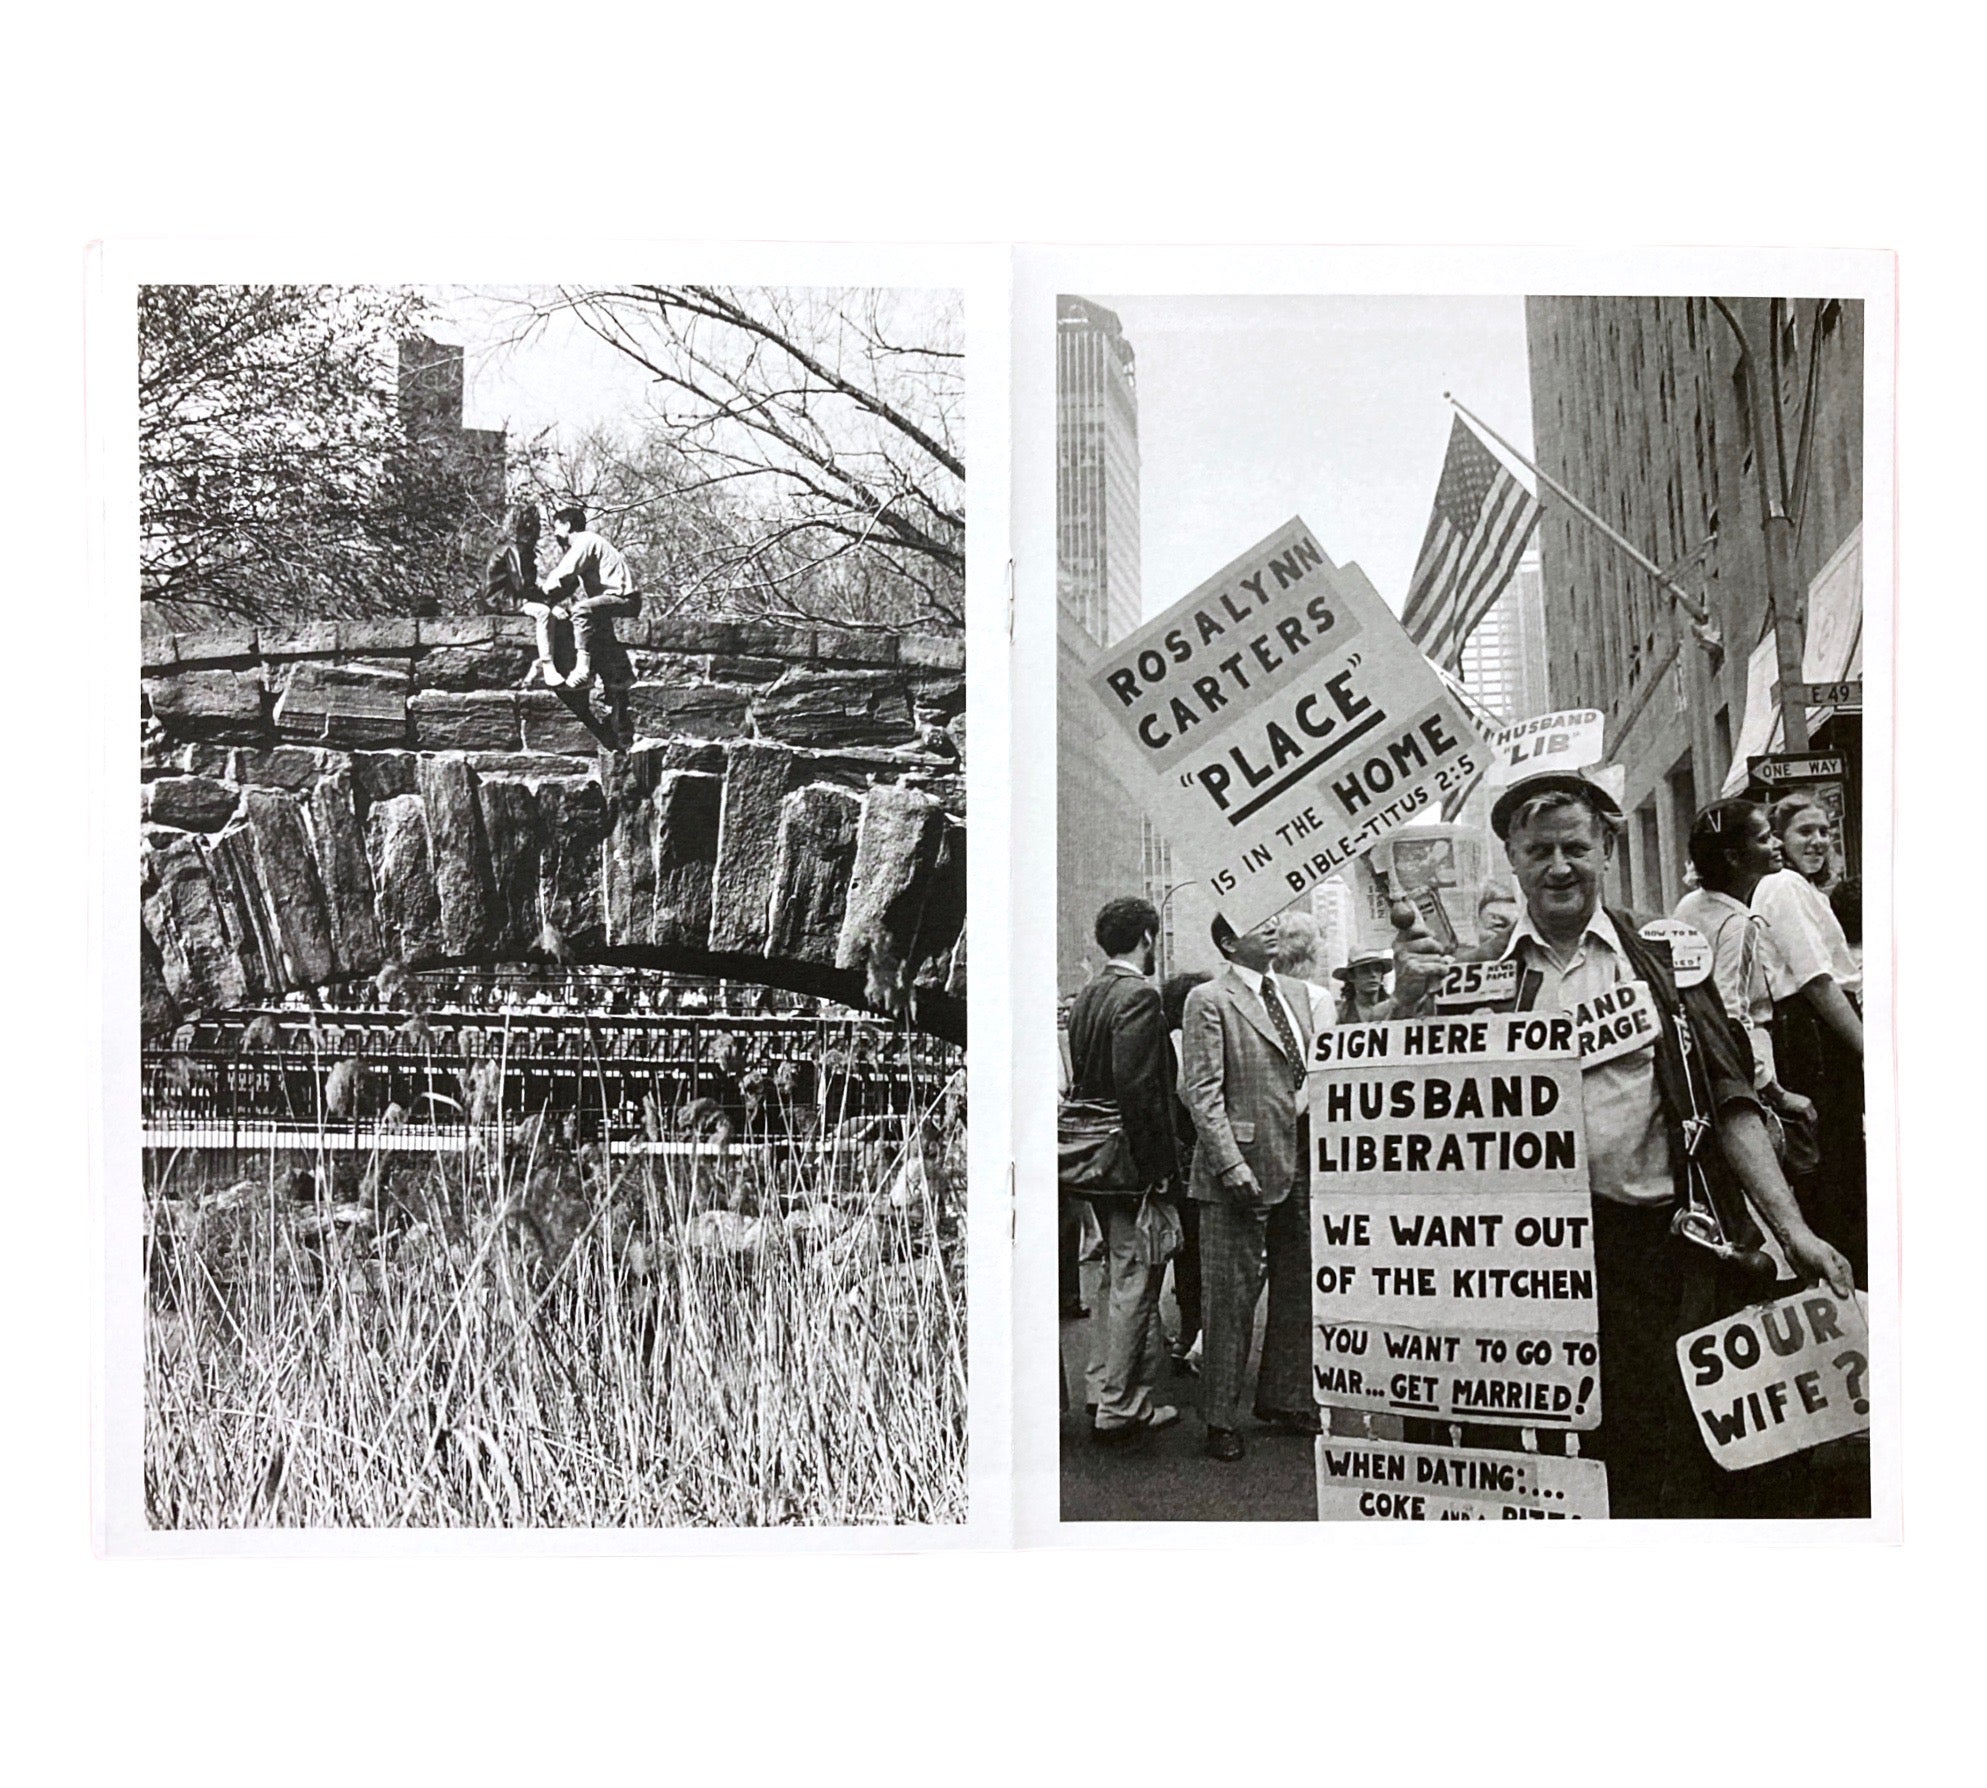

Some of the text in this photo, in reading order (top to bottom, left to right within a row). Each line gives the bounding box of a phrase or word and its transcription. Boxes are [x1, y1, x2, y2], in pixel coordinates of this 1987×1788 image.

[1107, 537, 1324, 707] ROSALYNN
[1138, 596, 1335, 749] CARTERS
[1812, 687, 1821, 703] E
[1828, 685, 1849, 703] 49
[1181, 653, 1372, 810] “PLACE”
[1497, 712, 1597, 745] HUSBAND
[1762, 760, 1837, 778] ONE WAY
[1211, 714, 1458, 895] IS IN THE HOME
[1285, 754, 1475, 893] BIBLE TITUS 2:5
[1563, 987, 1636, 1028] AND
[1315, 1018, 1573, 1062] SIGN HERE FOR
[1327, 1076, 1559, 1122] HUSBAND
[1318, 1130, 1576, 1172] LIBERATION
[1323, 1214, 1589, 1248] WE WANT OUT
[1316, 1266, 1593, 1299] OF THE KITCHEN
[1319, 1324, 1597, 1366] YOU WANT TO GO TO
[1689, 1298, 1845, 1386] SOUR
[1314, 1365, 1594, 1415] WAR... GET MARRIED!
[1702, 1350, 1869, 1446] WIFE?
[1325, 1450, 1404, 1481] WHEN
[1359, 1492, 1425, 1520] COKE
